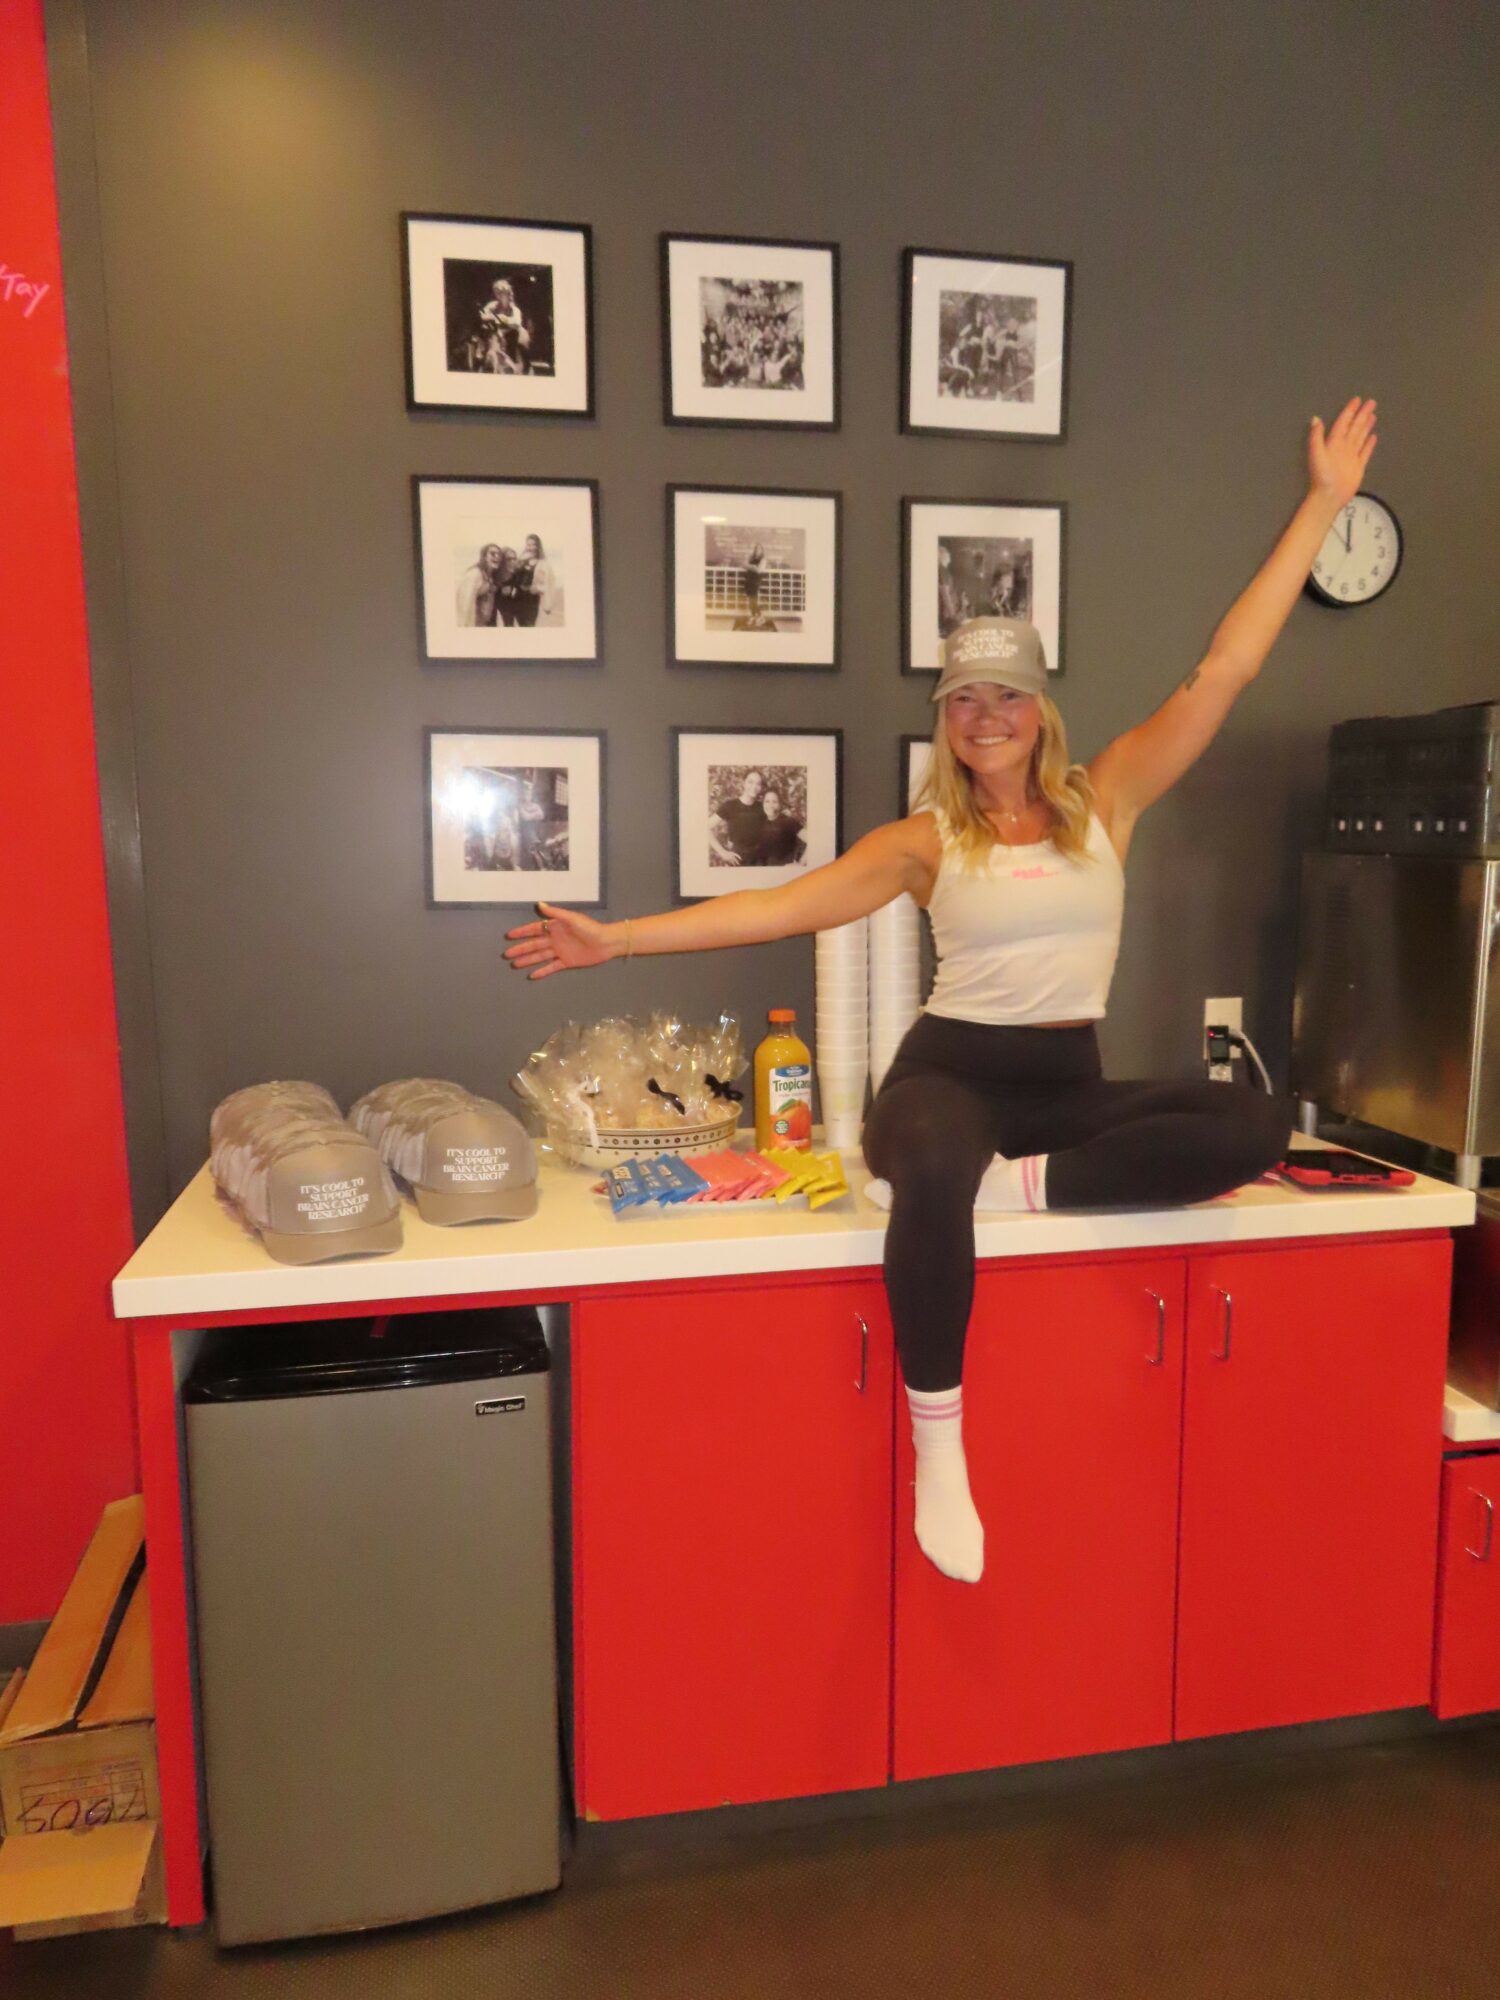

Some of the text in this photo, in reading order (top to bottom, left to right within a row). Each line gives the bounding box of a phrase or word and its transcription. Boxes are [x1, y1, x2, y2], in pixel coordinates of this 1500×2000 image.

[1345, 506, 1356, 519] 12
[1374, 526, 1383, 539] 2
[1378, 546, 1386, 559] 3
[1314, 561, 1322, 574] 8
[1370, 565, 1379, 576] 4
[1326, 576, 1333, 587] 7
[1358, 578, 1367, 591] 5
[1340, 582, 1349, 595] 6
[465, 1148, 491, 1157] COOL
[493, 1147, 506, 1155] TO
[454, 1156, 498, 1165] SUPPORT
[443, 1162, 510, 1173] BRAIN CANCER
[321, 1181, 350, 1193] COOL
[350, 1177, 364, 1187] TO
[310, 1188, 358, 1202] SUPPORT
[297, 1193, 369, 1212] BRAIN CANCER
